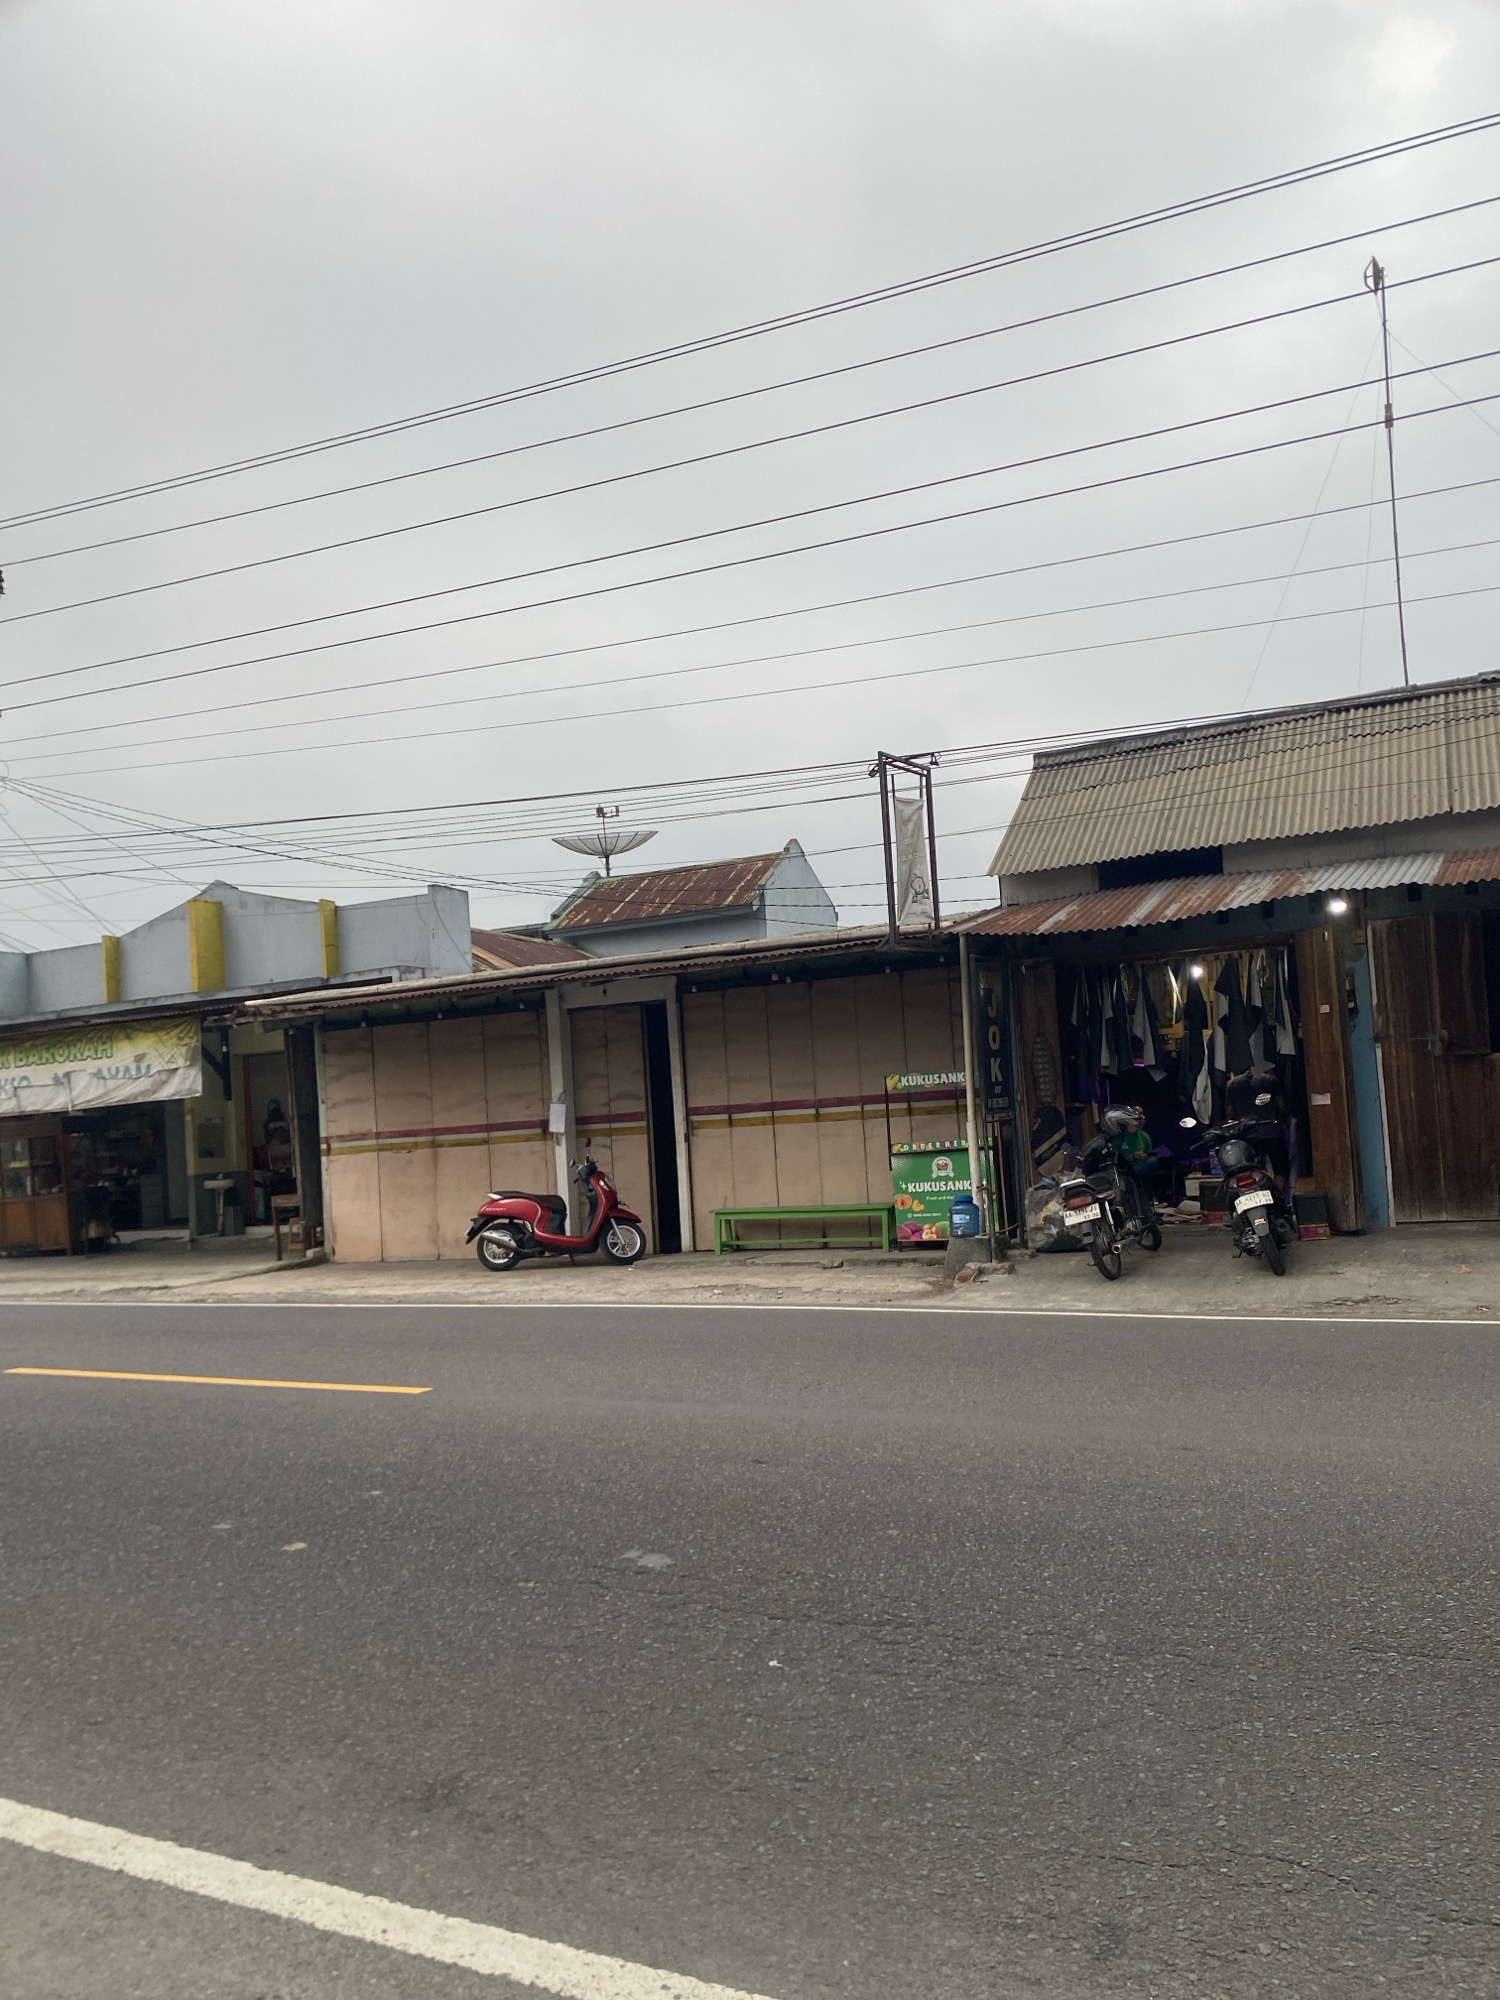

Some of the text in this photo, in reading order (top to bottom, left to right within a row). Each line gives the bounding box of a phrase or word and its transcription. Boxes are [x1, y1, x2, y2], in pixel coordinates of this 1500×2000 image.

[987, 991, 1003, 1082] JOK
[14, 1036, 114, 1068] BAROKAH
[901, 1072, 966, 1087] KUKUSANK
[903, 1140, 940, 1151] ORDER
[907, 1180, 973, 1193] KUKUSANK
